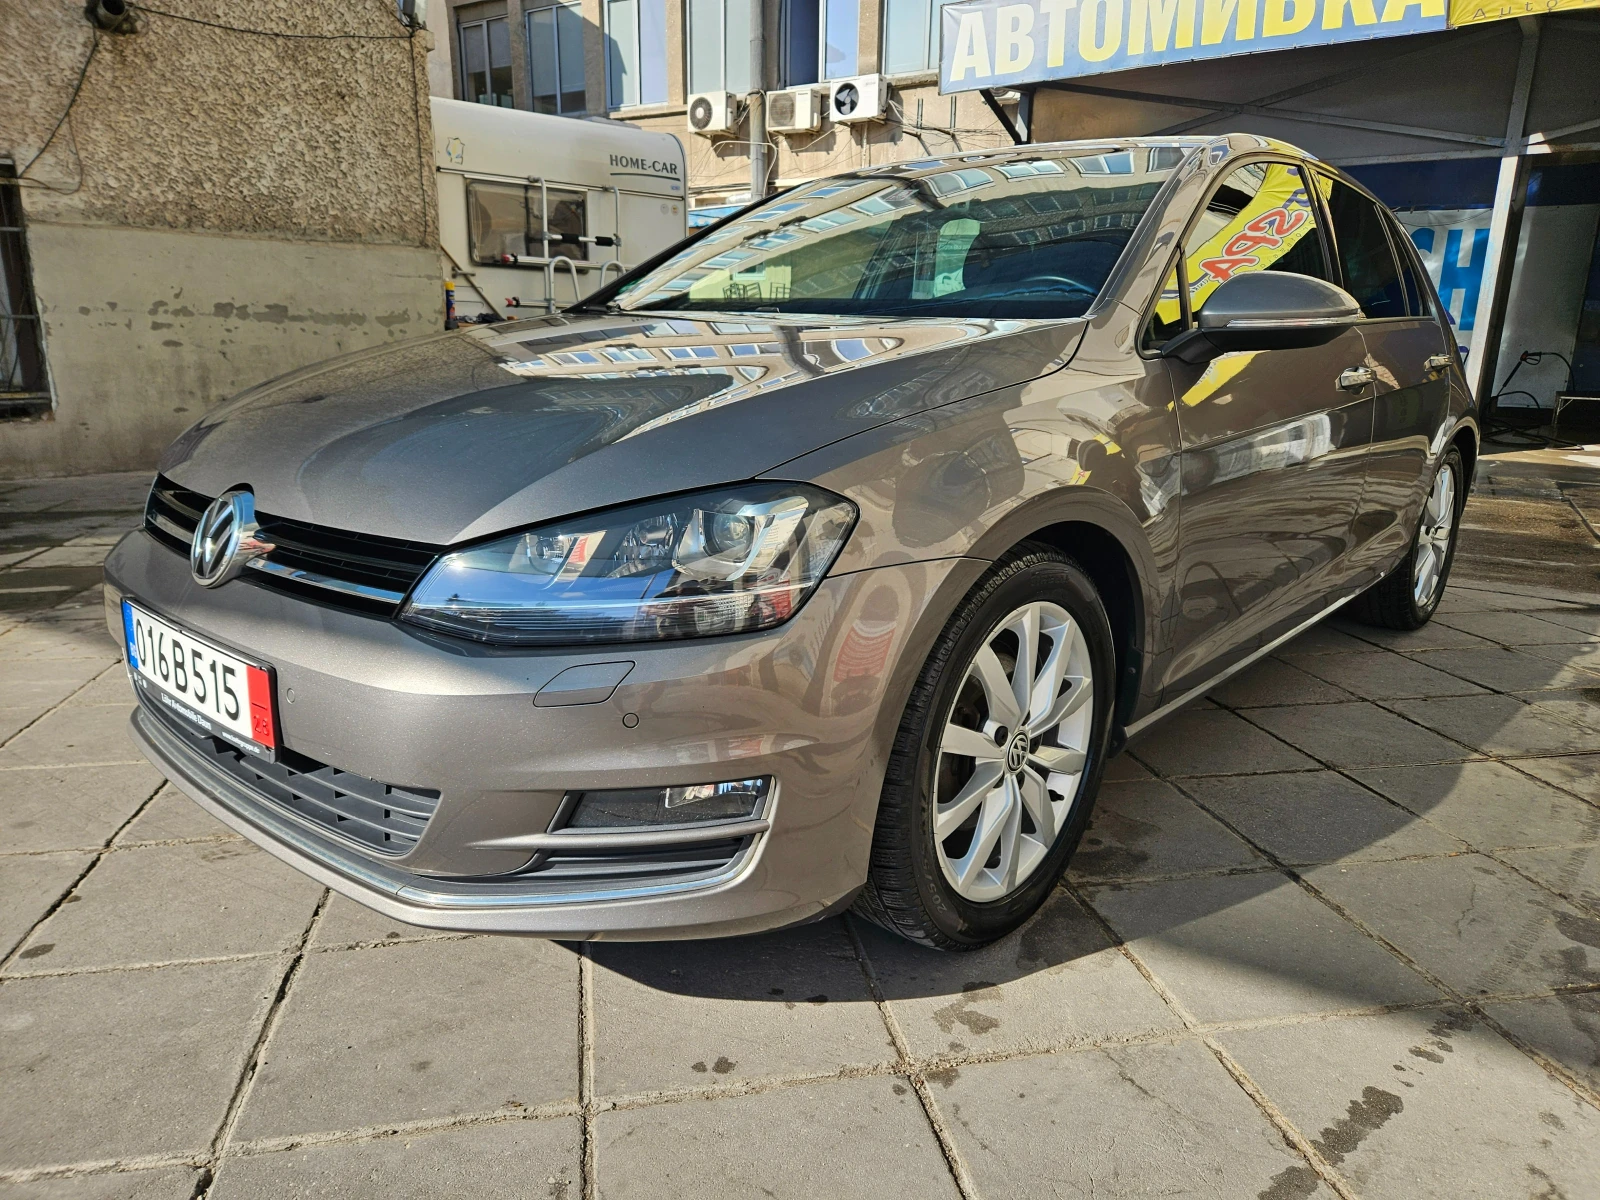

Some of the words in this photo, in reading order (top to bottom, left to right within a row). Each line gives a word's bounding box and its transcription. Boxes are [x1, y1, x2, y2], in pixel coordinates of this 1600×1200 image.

[1472, 0, 1558, 20] Auto
[950, 0, 1444, 82] АВТОМИ
[609, 154, 678, 175] HOME-CAR
[1409, 227, 1491, 332] H
